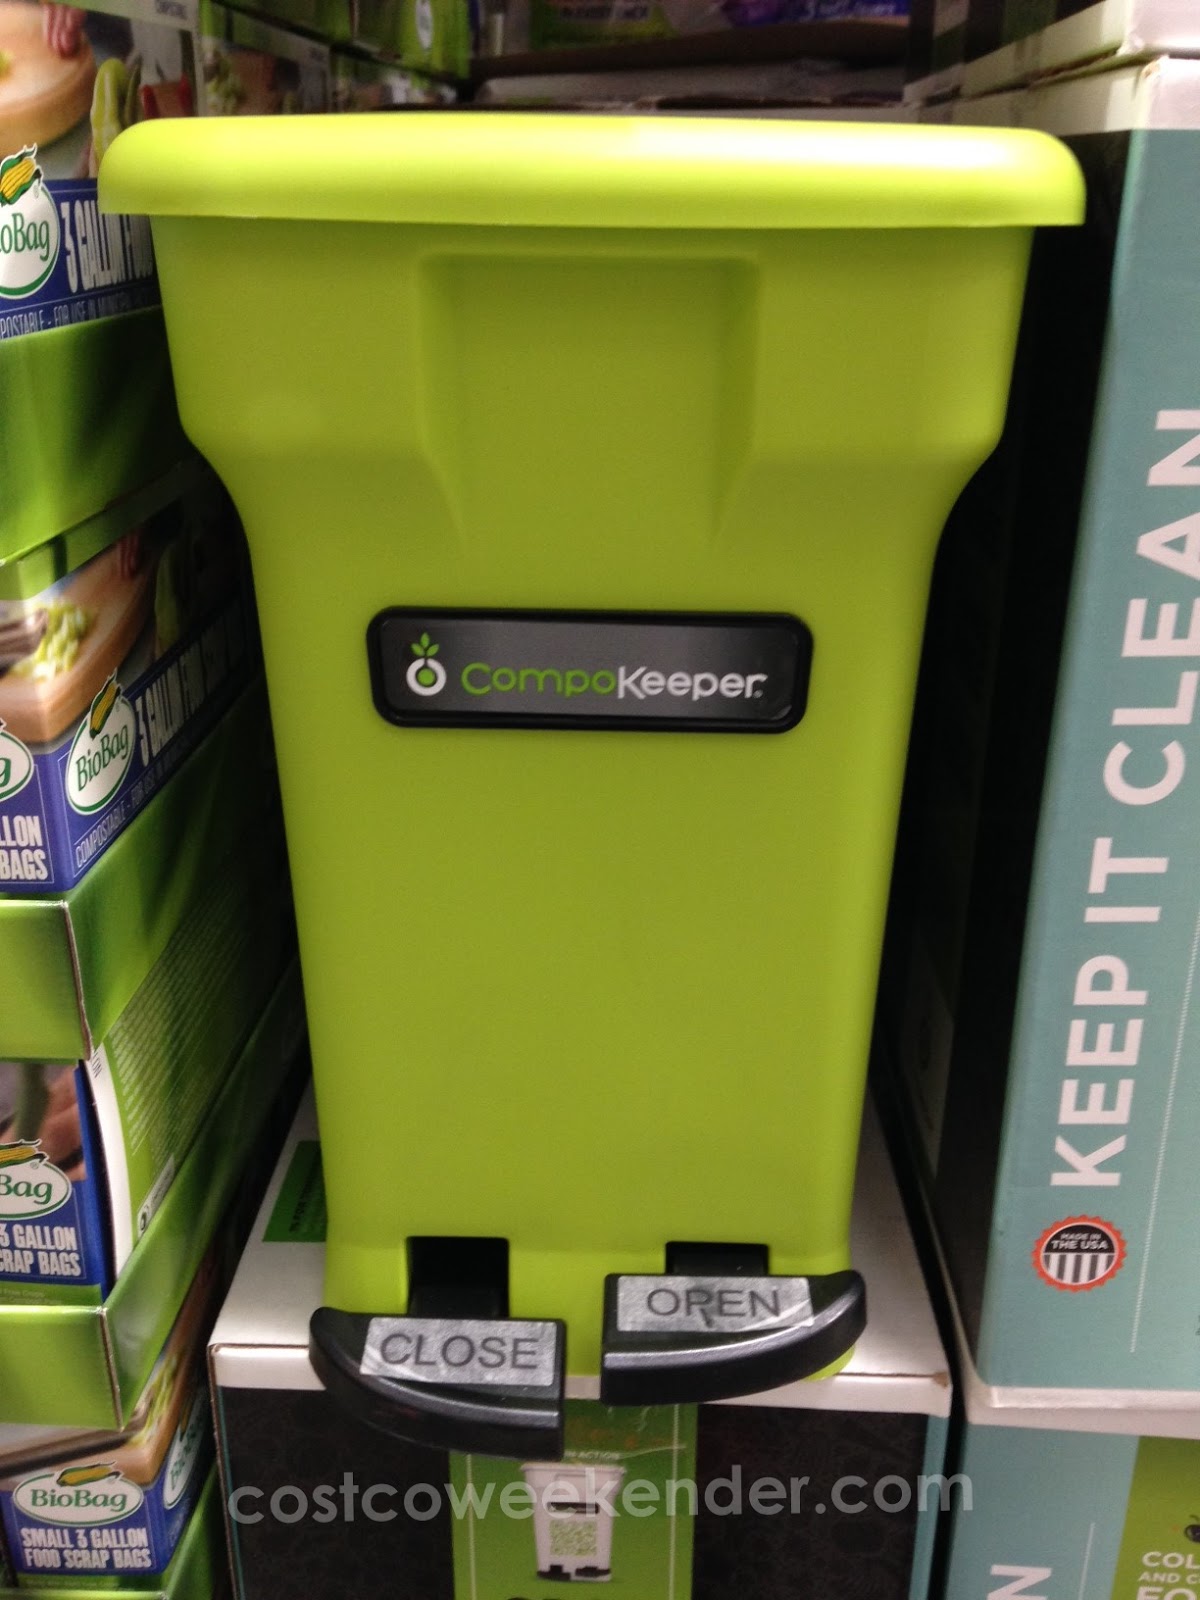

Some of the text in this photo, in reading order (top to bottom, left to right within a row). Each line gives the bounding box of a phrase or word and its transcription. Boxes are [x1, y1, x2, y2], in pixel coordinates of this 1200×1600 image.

[60, 201, 78, 293] 3
[75, 724, 129, 792] BioBag
[1050, 410, 1200, 1186] KEEP IT CLEAN
[12, 1224, 77, 1251] GALLON
[1051, 1240, 1108, 1250] THE USA
[37, 1251, 81, 1277] BAGS
[379, 1333, 540, 1369] CLOSE
[30, 1489, 128, 1512] BioBag
[20, 1528, 148, 1548] SMALL 3 GALLON
[25, 1549, 152, 1568] FOOD SCRAP BAGS
[1138, 1571, 1181, 1583] AND
